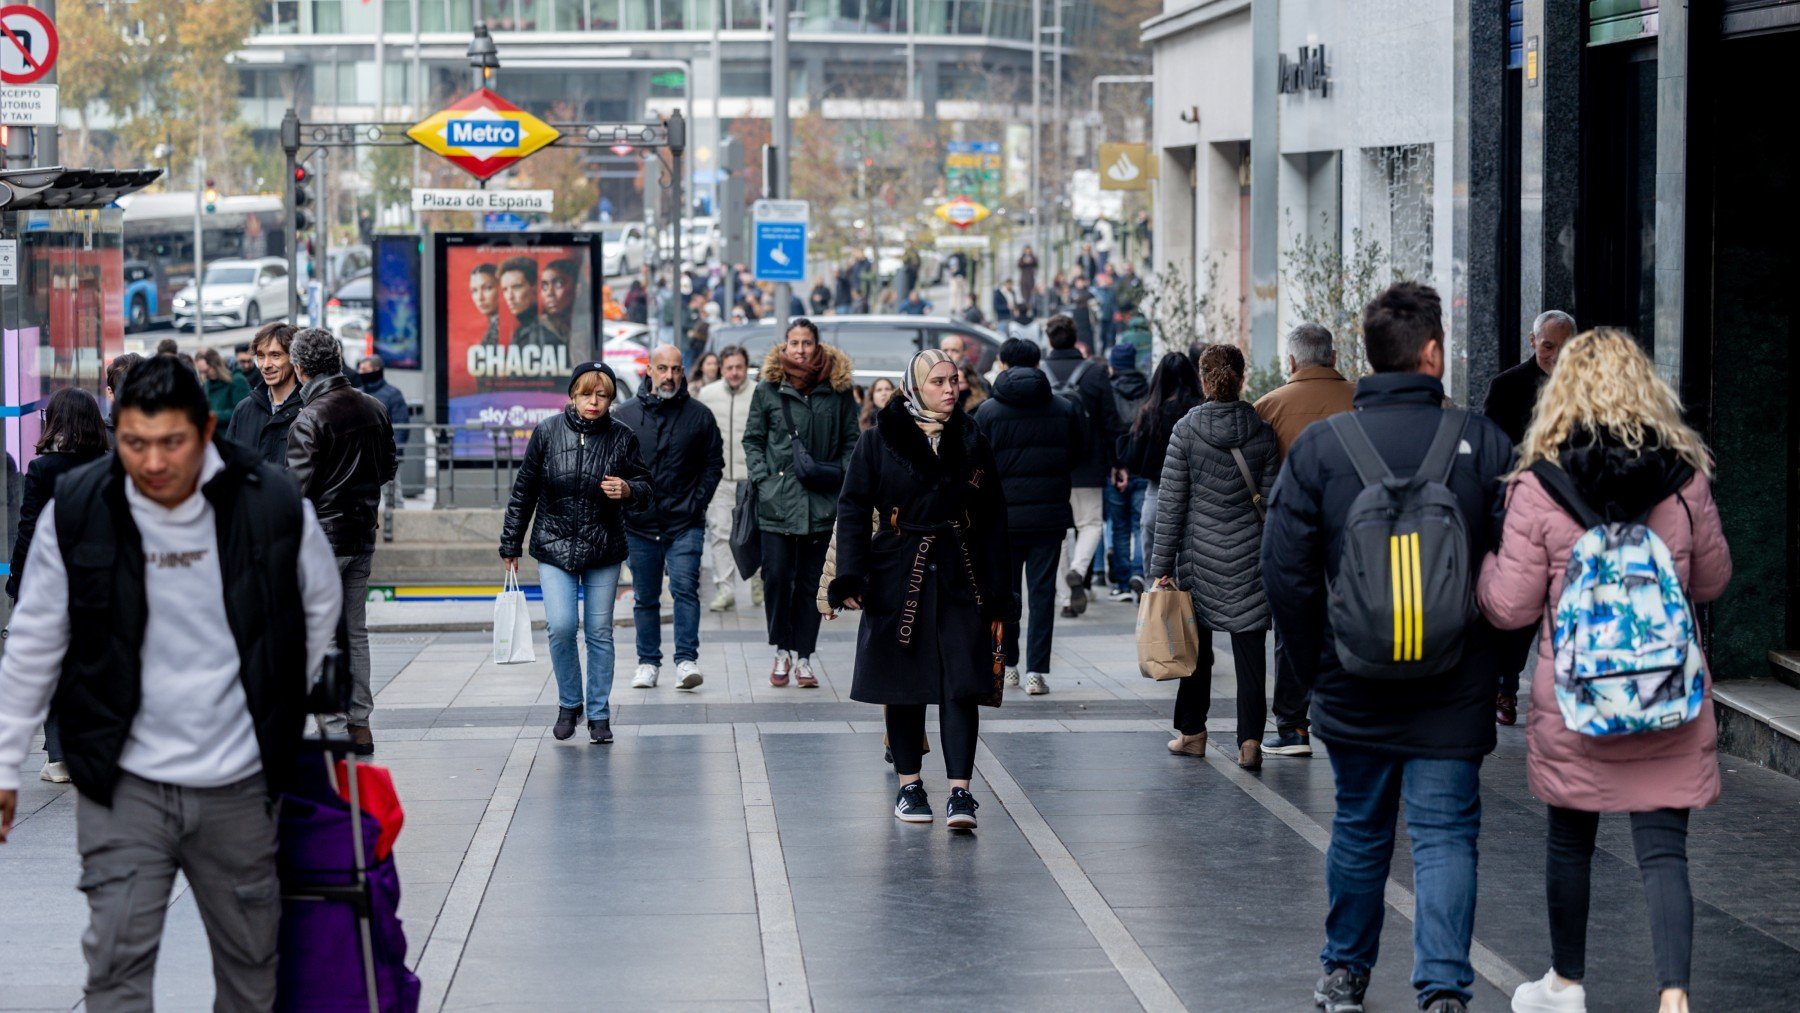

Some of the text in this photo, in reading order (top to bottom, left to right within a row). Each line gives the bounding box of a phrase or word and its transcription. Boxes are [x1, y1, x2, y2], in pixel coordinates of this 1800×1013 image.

[2, 112, 32, 120] Y TAXI
[453, 122, 515, 143] Metro
[422, 194, 543, 210] Plaza de España
[467, 344, 573, 377] CHACAL
[899, 535, 936, 644] LOUIS VUITTON
